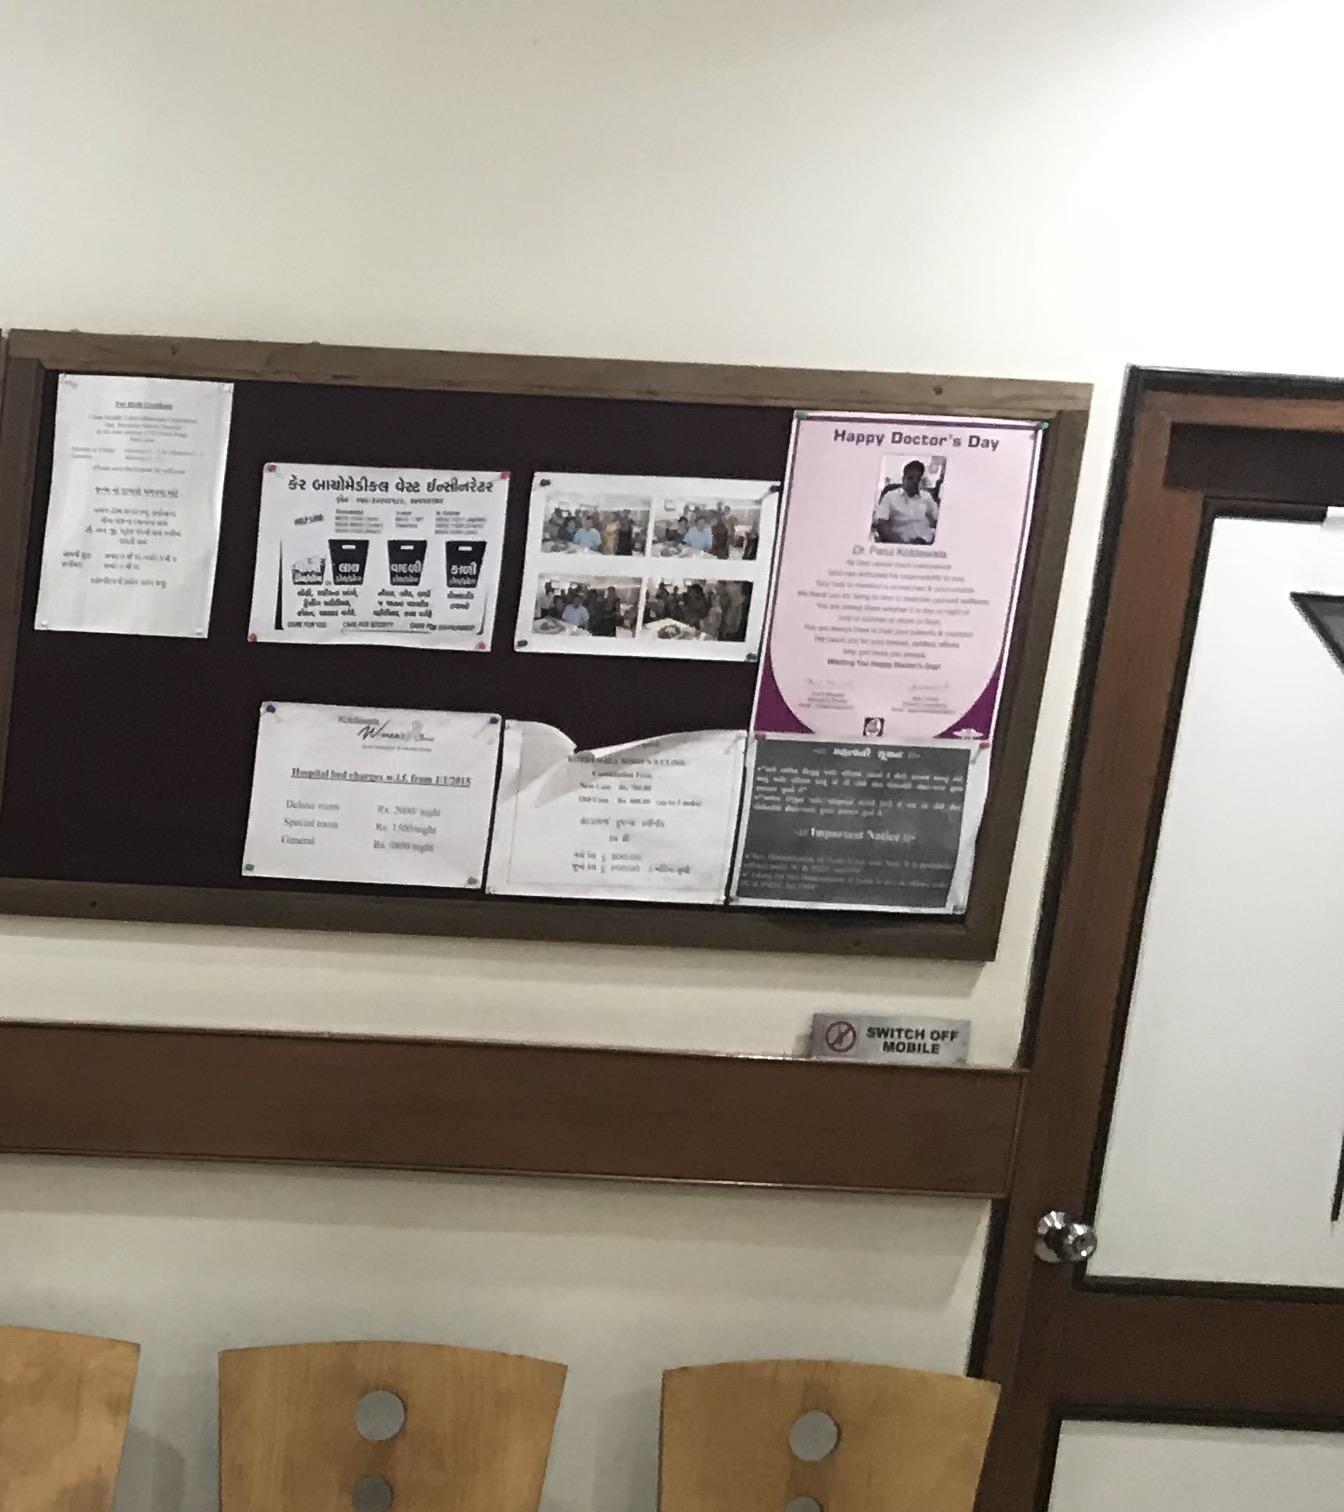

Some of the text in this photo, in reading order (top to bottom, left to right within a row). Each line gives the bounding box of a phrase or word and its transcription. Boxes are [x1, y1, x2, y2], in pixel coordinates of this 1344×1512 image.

[833, 429, 1000, 451] Happy Doctor's Day
[288, 474, 306, 491] કેર
[291, 767, 330, 780] Hospital
[331, 769, 348, 781] bed
[349, 771, 384, 783] charges
[410, 773, 433, 785] from
[866, 1026, 960, 1042] SWITCH OFF
[882, 1041, 941, 1055] MOBILE
